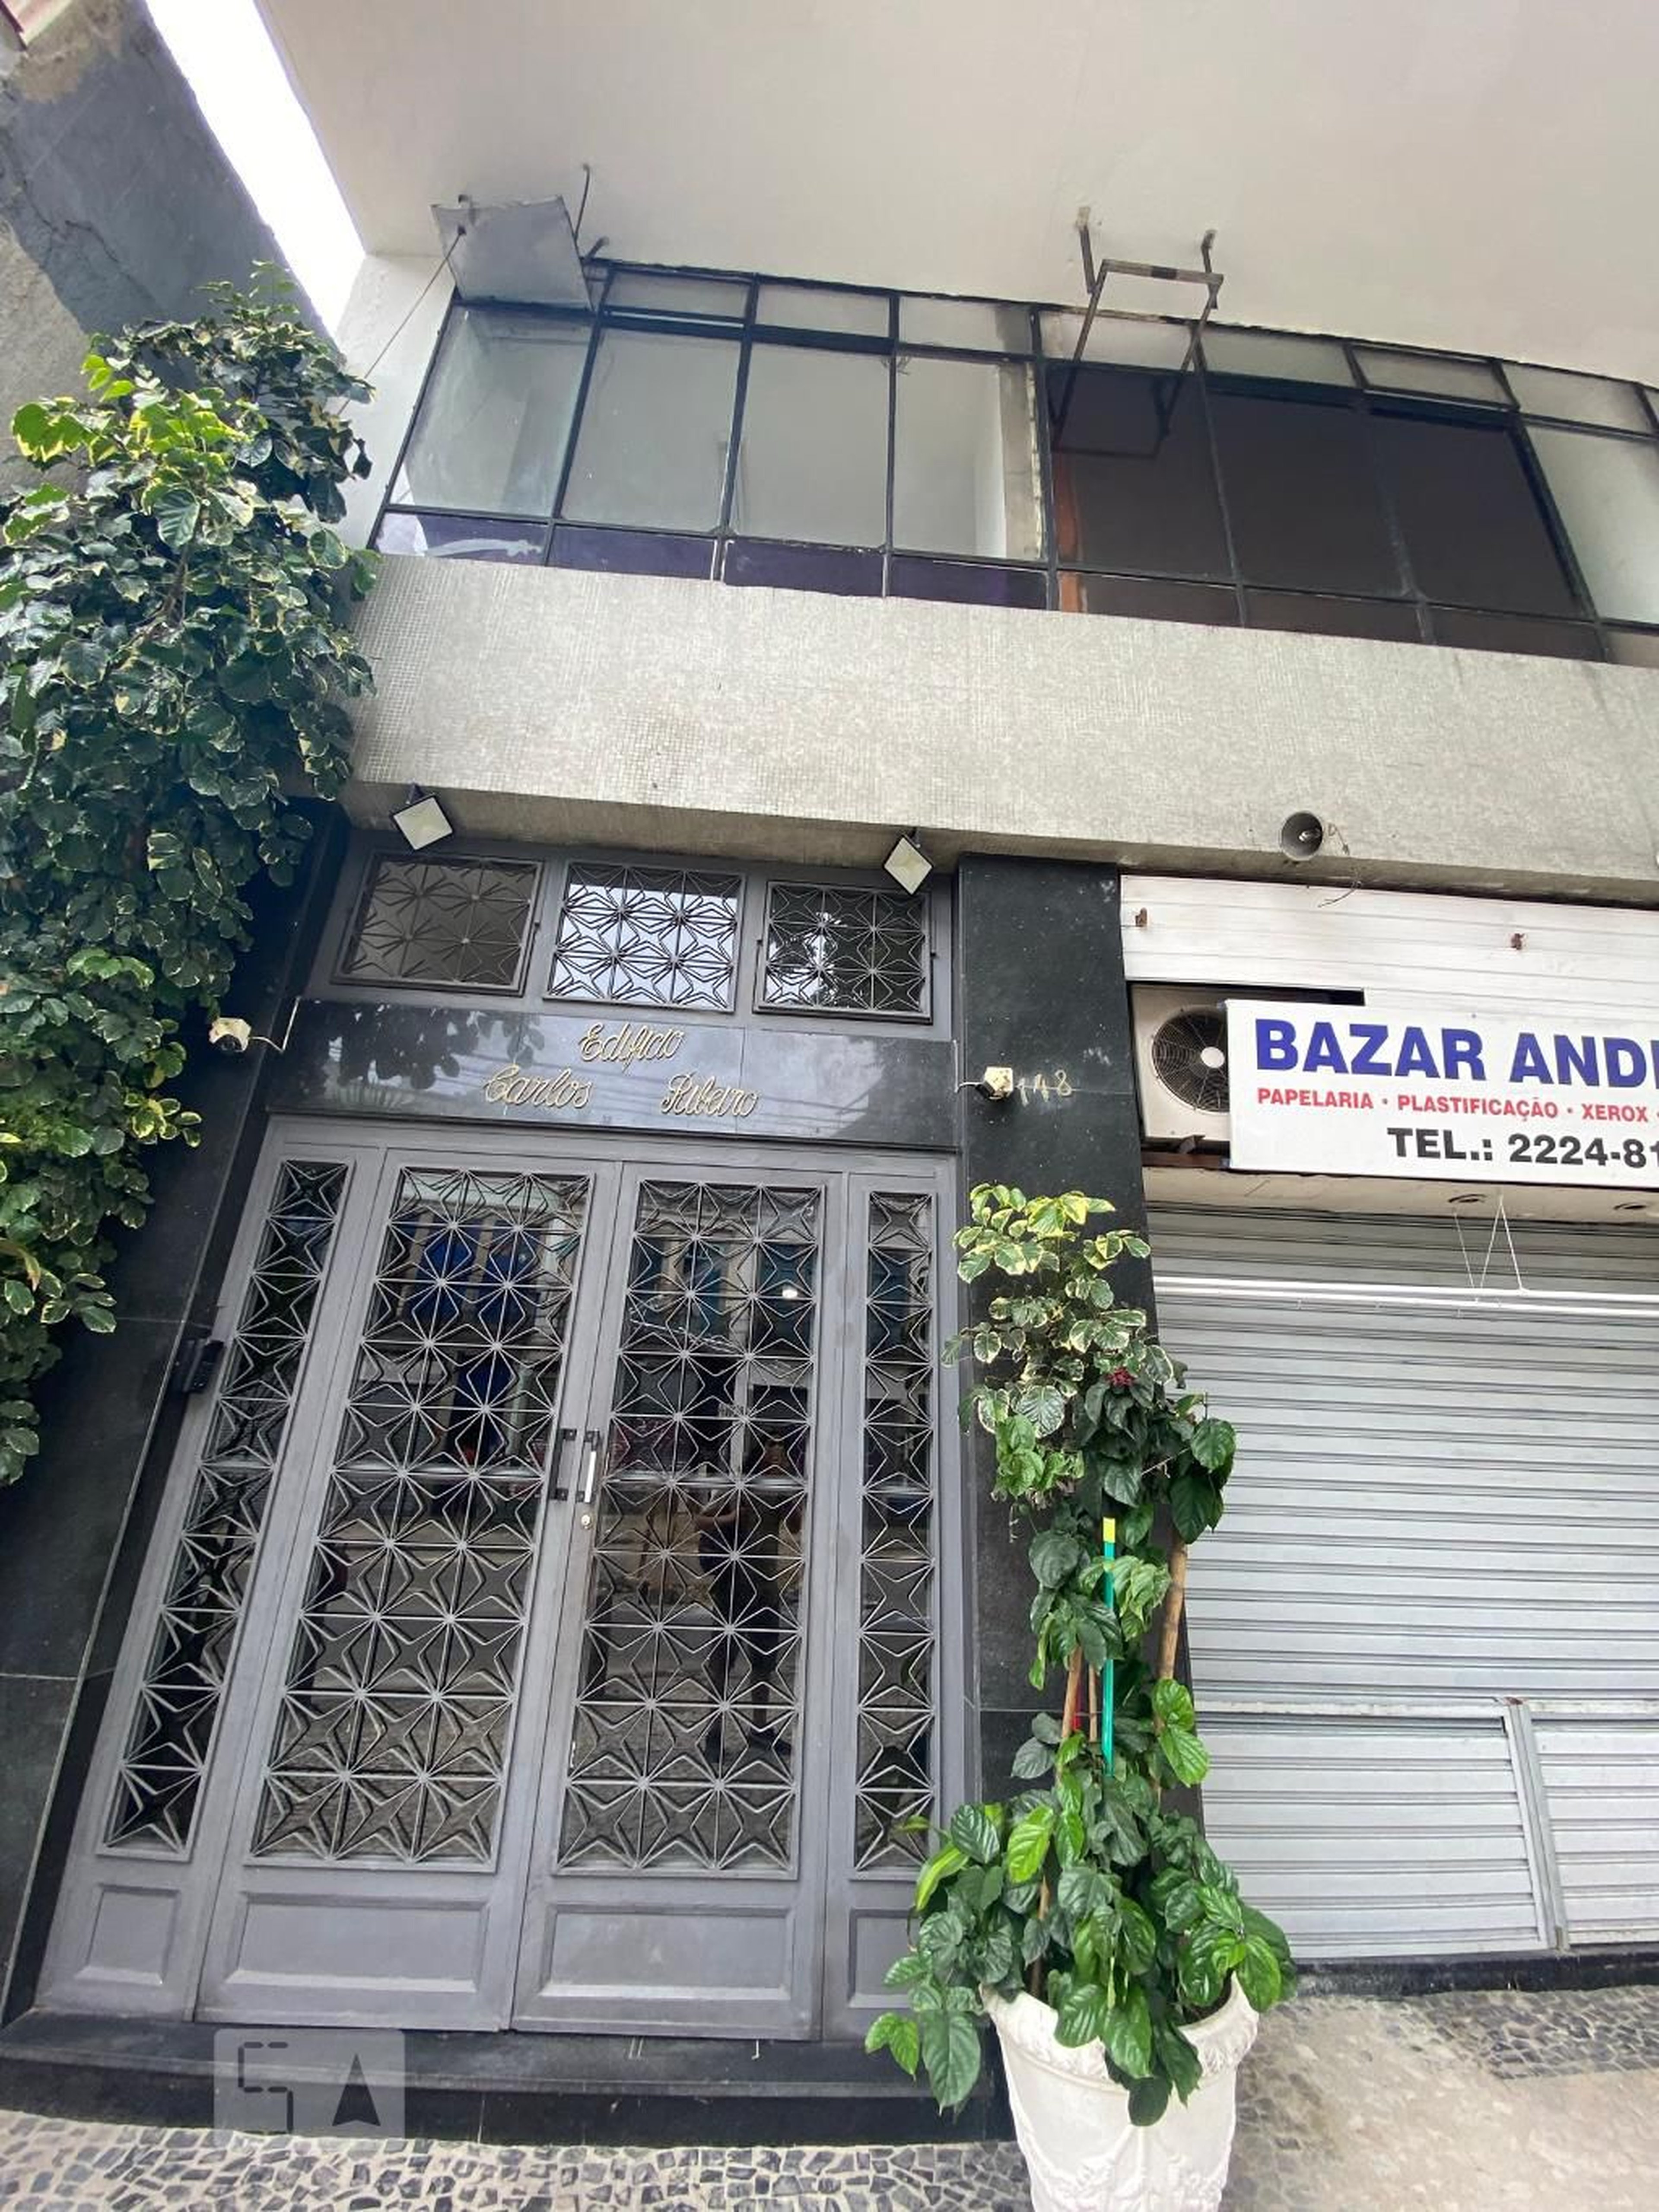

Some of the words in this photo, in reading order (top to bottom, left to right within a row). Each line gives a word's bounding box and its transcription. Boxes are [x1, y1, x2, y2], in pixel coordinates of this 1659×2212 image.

[1255, 1018, 1487, 1080] BAZAR
[483, 1063, 594, 1108] Carlos
[660, 1073, 760, 1118] Ribeiro
[1257, 1088, 1373, 1109] PAPELARIA
[1398, 1095, 1558, 1122] PLASTIFICAÇÃO
[1582, 1103, 1648, 1123] XEROX
[1387, 1127, 1493, 1161] TEL.:
